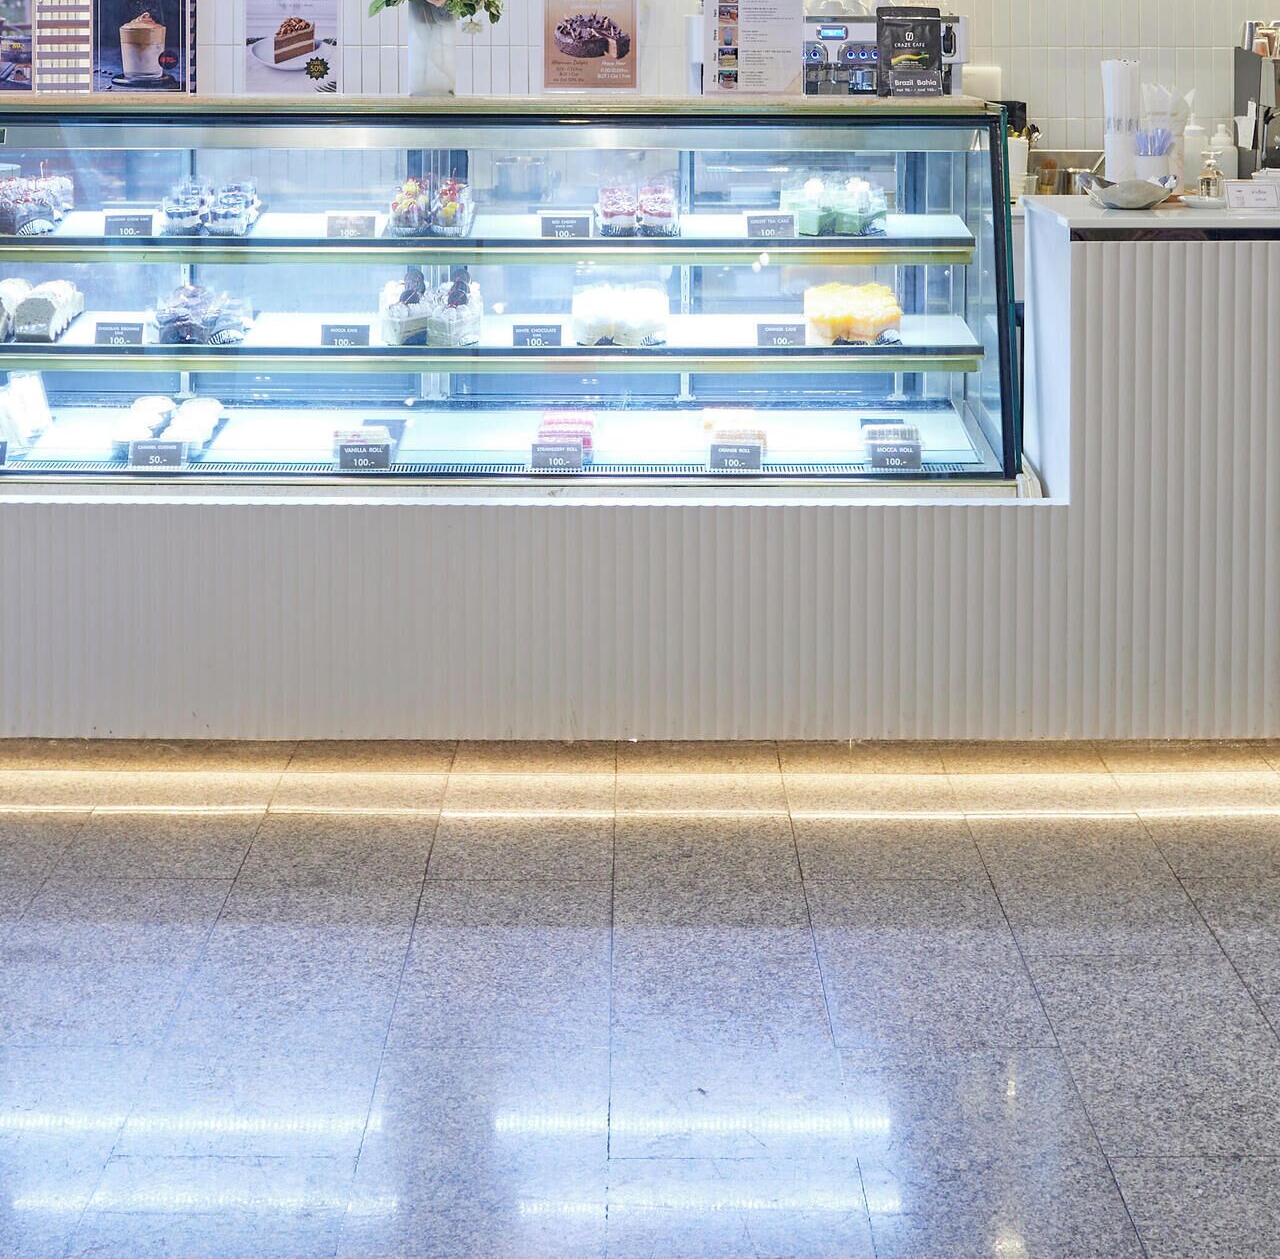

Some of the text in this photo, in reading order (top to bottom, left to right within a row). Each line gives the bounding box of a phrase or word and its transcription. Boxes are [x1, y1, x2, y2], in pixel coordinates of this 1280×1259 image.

[119, 227, 141, 235] 100.-
[555, 230, 576, 238] 100.-
[110, 336, 131, 345] 100.-
[334, 338, 356, 346] 100.-
[525, 338, 549, 346] 100.-
[773, 337, 794, 346] 100.-
[148, 455, 168, 464] 50.-
[353, 458, 376, 467] 100.-
[548, 457, 570, 466] 100.-
[724, 458, 746, 467] 100.-
[885, 457, 908, 466] 100.-
